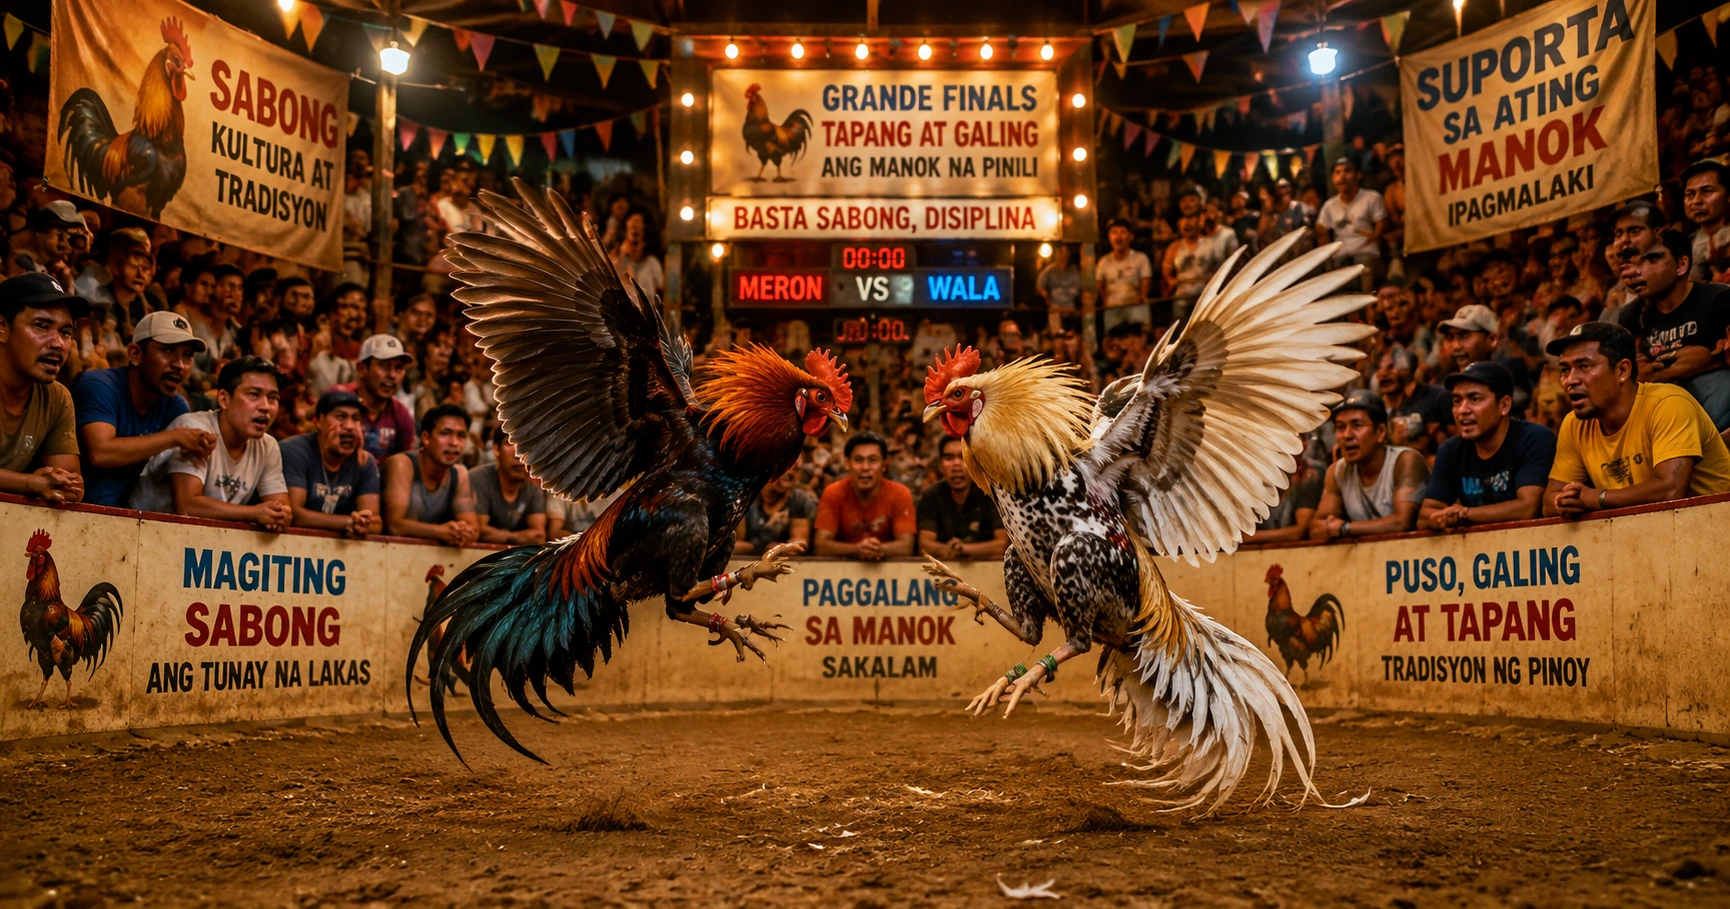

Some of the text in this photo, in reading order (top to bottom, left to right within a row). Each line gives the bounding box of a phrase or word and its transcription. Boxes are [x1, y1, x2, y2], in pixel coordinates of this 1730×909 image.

[1417, 0, 1635, 112] SUPORTA
[210, 59, 339, 149] SABONG
[822, 84, 1038, 112] GRANDE FINALS
[1443, 65, 1600, 145] SA ATING
[211, 121, 334, 191] KULTURA AT
[821, 120, 1039, 148] TAPANG AT GALING
[1438, 104, 1608, 196] MANOK
[821, 156, 1038, 178] ANG MANOK NA PINILI
[215, 168, 327, 232] TRADISYON
[1448, 164, 1594, 228] IPAGMALAKI
[733, 206, 1036, 233] BASTA SABONG, DISIPLINA
[843, 247, 905, 269] 00:00
[739, 275, 1001, 301] MERON VS WALA
[183, 547, 346, 596] MAGITING
[1386, 545, 1581, 597] PUSO, GALING
[184, 602, 341, 647] SABONG
[805, 615, 956, 646] SA MANOK
[1393, 597, 1577, 643] AT TAPANG
[145, 659, 372, 694] ANG TUNAY NA LAKAS
[822, 656, 937, 678] SAKALAM
[1381, 655, 1591, 688] TRADISYON NG PINOY
